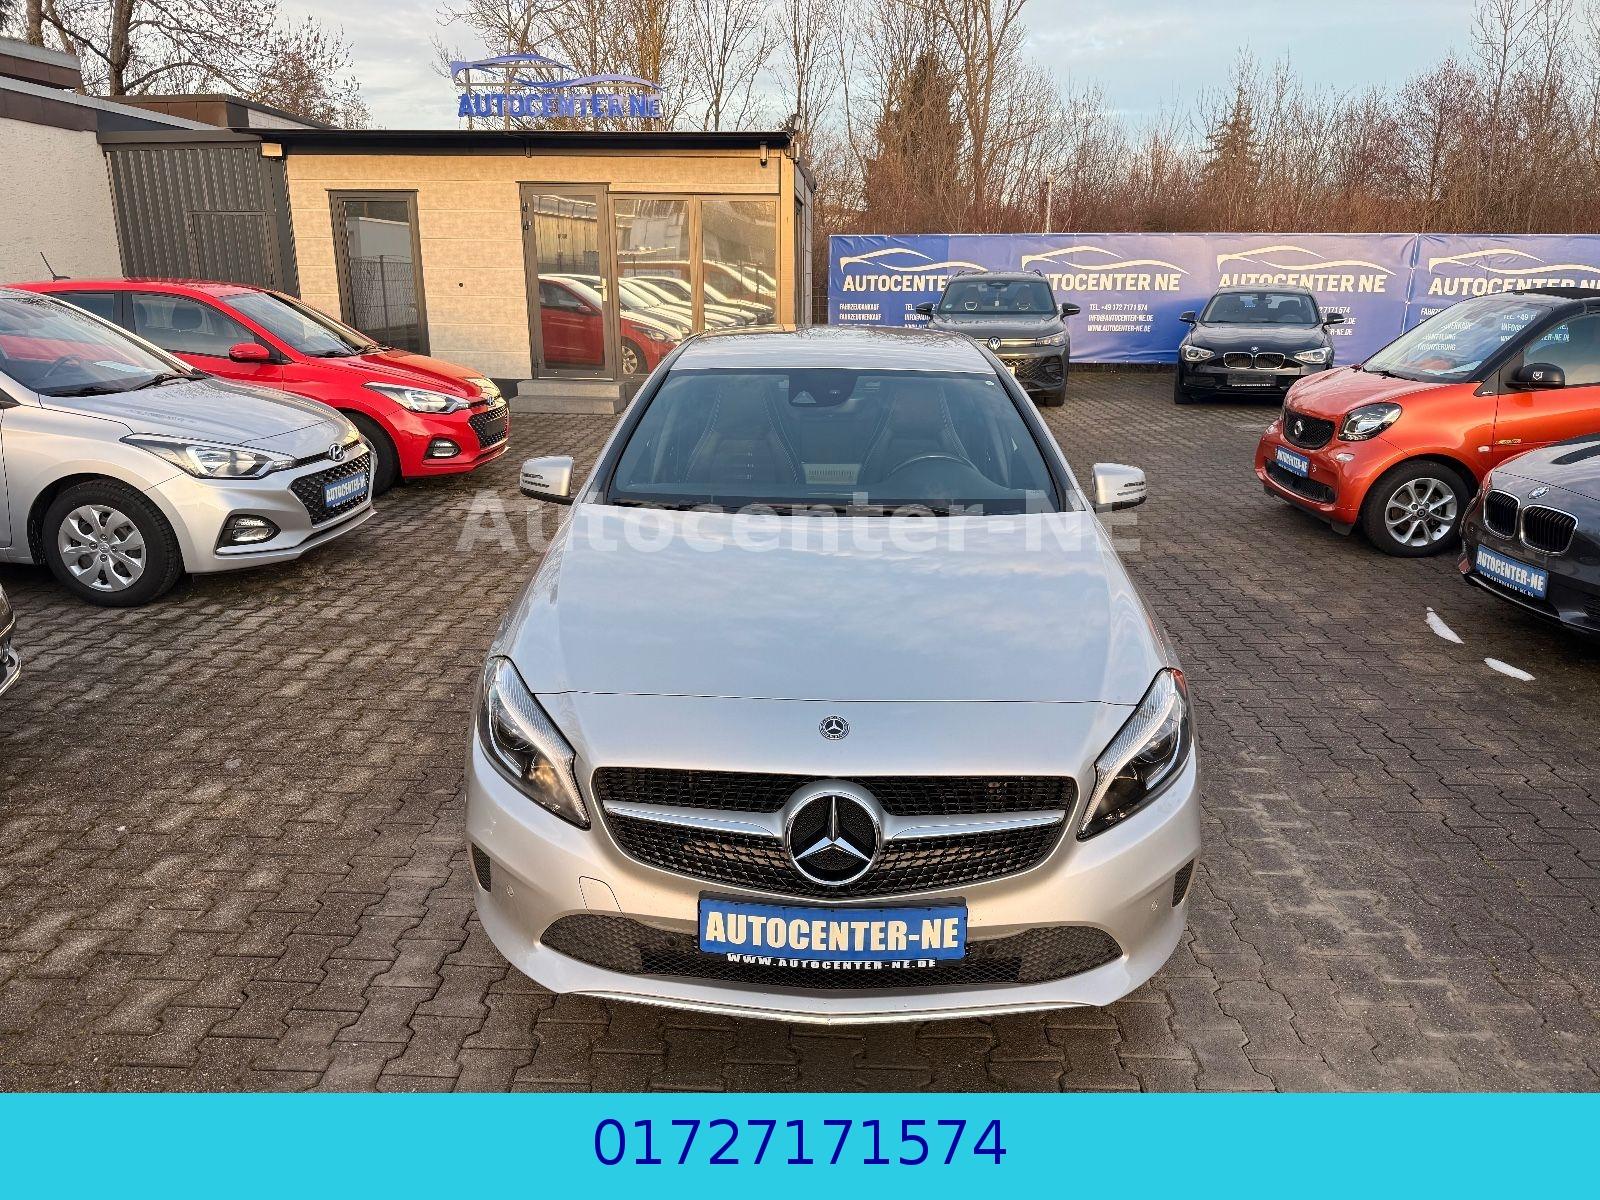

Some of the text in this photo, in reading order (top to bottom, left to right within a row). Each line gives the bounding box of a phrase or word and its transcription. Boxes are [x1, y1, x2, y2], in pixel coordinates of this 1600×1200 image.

[458, 93, 663, 118] AUTOCENTER NE
[843, 275, 952, 292] AUTOCENTE
[1046, 274, 1181, 291] TOCENTER NE
[1358, 275, 1388, 293] NE
[1477, 550, 1545, 592] AUTOCENTER-NE
[706, 911, 959, 952] AUTOCENTER-NE
[726, 952, 937, 970] WWW.AUTOCENTER-NE.DE
